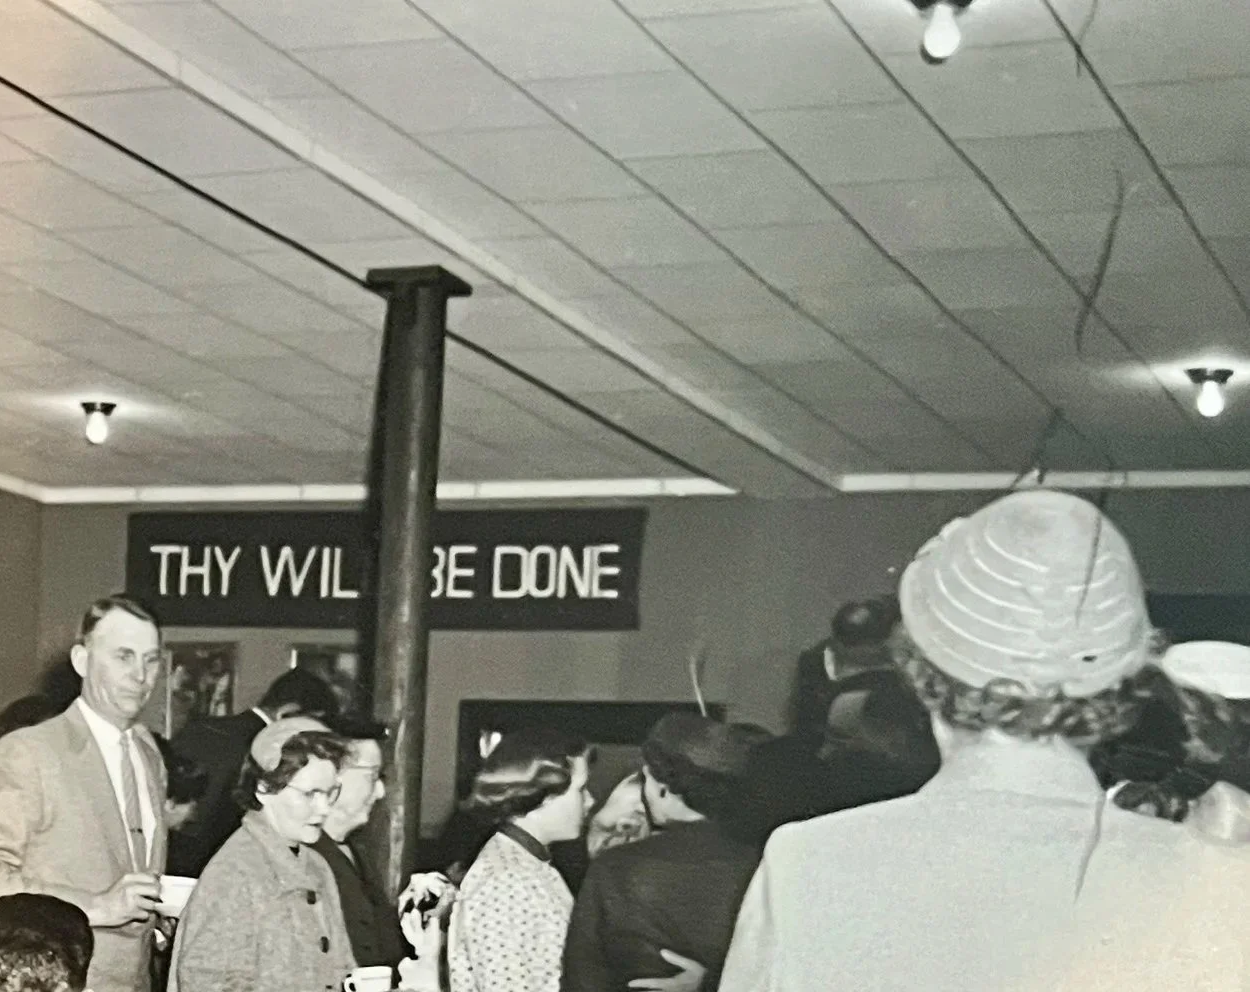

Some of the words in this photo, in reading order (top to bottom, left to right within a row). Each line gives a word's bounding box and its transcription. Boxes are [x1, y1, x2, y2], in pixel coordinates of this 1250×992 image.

[150, 545, 241, 596] THY
[260, 545, 360, 598] WIL
[492, 544, 621, 598] DONE
